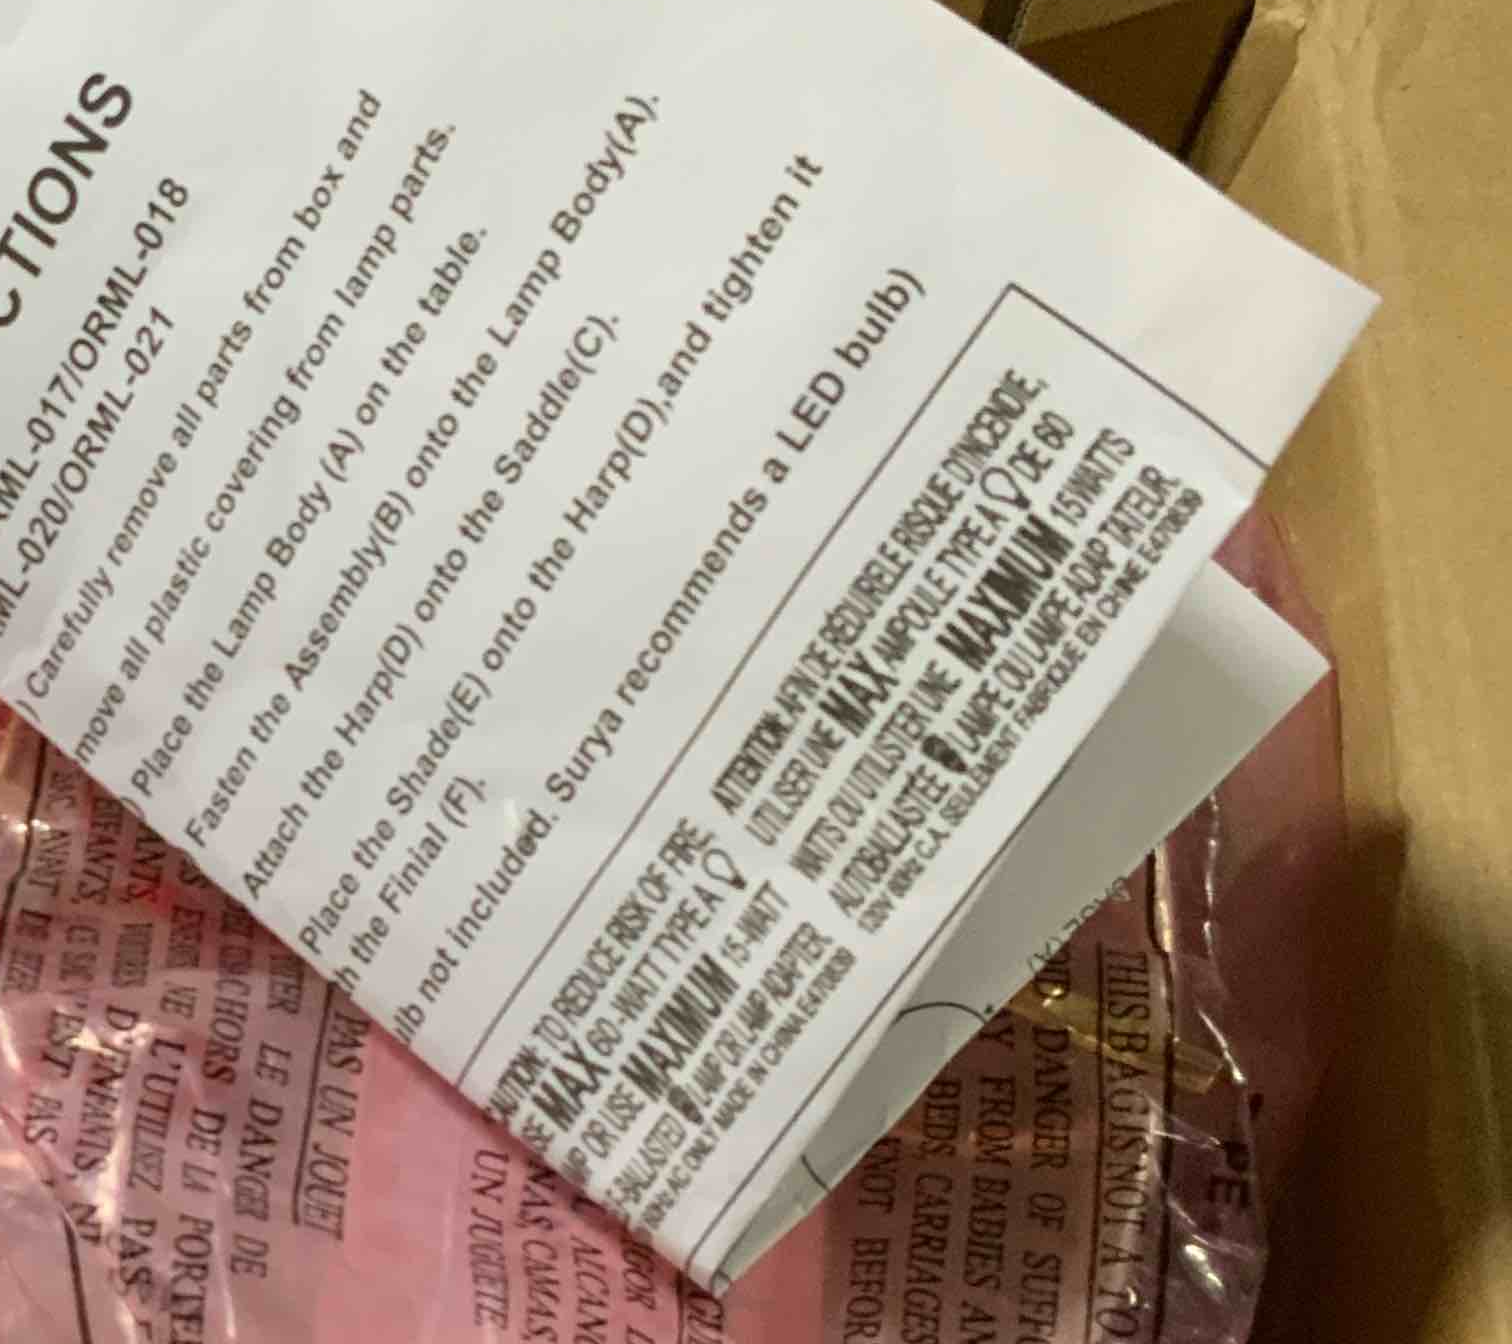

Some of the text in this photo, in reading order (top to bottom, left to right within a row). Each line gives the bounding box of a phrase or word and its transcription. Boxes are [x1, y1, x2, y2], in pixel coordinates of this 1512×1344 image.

[24, 89, 381, 698] Carefully remove all parts from box and
[120, 126, 455, 680] all plastic covering from lamp parts.
[130, 229, 486, 797] Place the Lamp Body (A) on the table.
[183, 96, 658, 848] Fasten the Assembly(B) onto the Lamp Body(A).
[242, 315, 618, 900] Attach the Harp(D) onto the Saddle(C).
[298, 873, 359, 955] Place
[352, 819, 395, 869] the
[386, 672, 490, 815] Shade(E)
[482, 597, 535, 671] onto
[528, 537, 574, 591] the
[701, 193, 799, 321] tighten
[785, 155, 822, 187] it
[799, 641, 840, 680] DE
[890, 472, 964, 555] RISQUE
[817, 650, 899, 737] MAX
[871, 567, 959, 671] AMPOULE
[934, 516, 996, 576] TYPE
[974, 504, 1008, 531] A
[1007, 440, 1053, 483] DE
[1032, 411, 1073, 450] 60
[909, 660, 961, 712] UNE
[935, 513, 1074, 672] MAXIMUM
[418, 268, 925, 1002] not included. Surya recommends a LED bulb)
[1074, 615, 1106, 646] EN
[349, 776, 485, 964] the Finial (F).
[530, 884, 724, 1132] MAX TYPE A
[531, 862, 671, 1049] TO REDUCE RISK OF
[619, 952, 738, 1101] MAXIMUM
[1101, 948, 1155, 1020] THIS
[182, 1105, 227, 1157] DE
[253, 1040, 292, 1087] LE
[297, 1010, 371, 1241] PAS UN JOUET
[598, 1082, 645, 1131] USE
[971, 1073, 1018, 1167] FROM
[1023, 1024, 1078, 1171] DANGER
[1101, 1027, 1159, 1117] BAG
[468, 1149, 509, 1204] UN
[1025, 1192, 1064, 1231] OF
[1100, 1162, 1152, 1234] NOT
[1106, 1122, 1153, 1156] IS
[226, 1233, 271, 1279] DE
[960, 1174, 1012, 1295] BABIES
[1098, 1241, 1146, 1270] A
